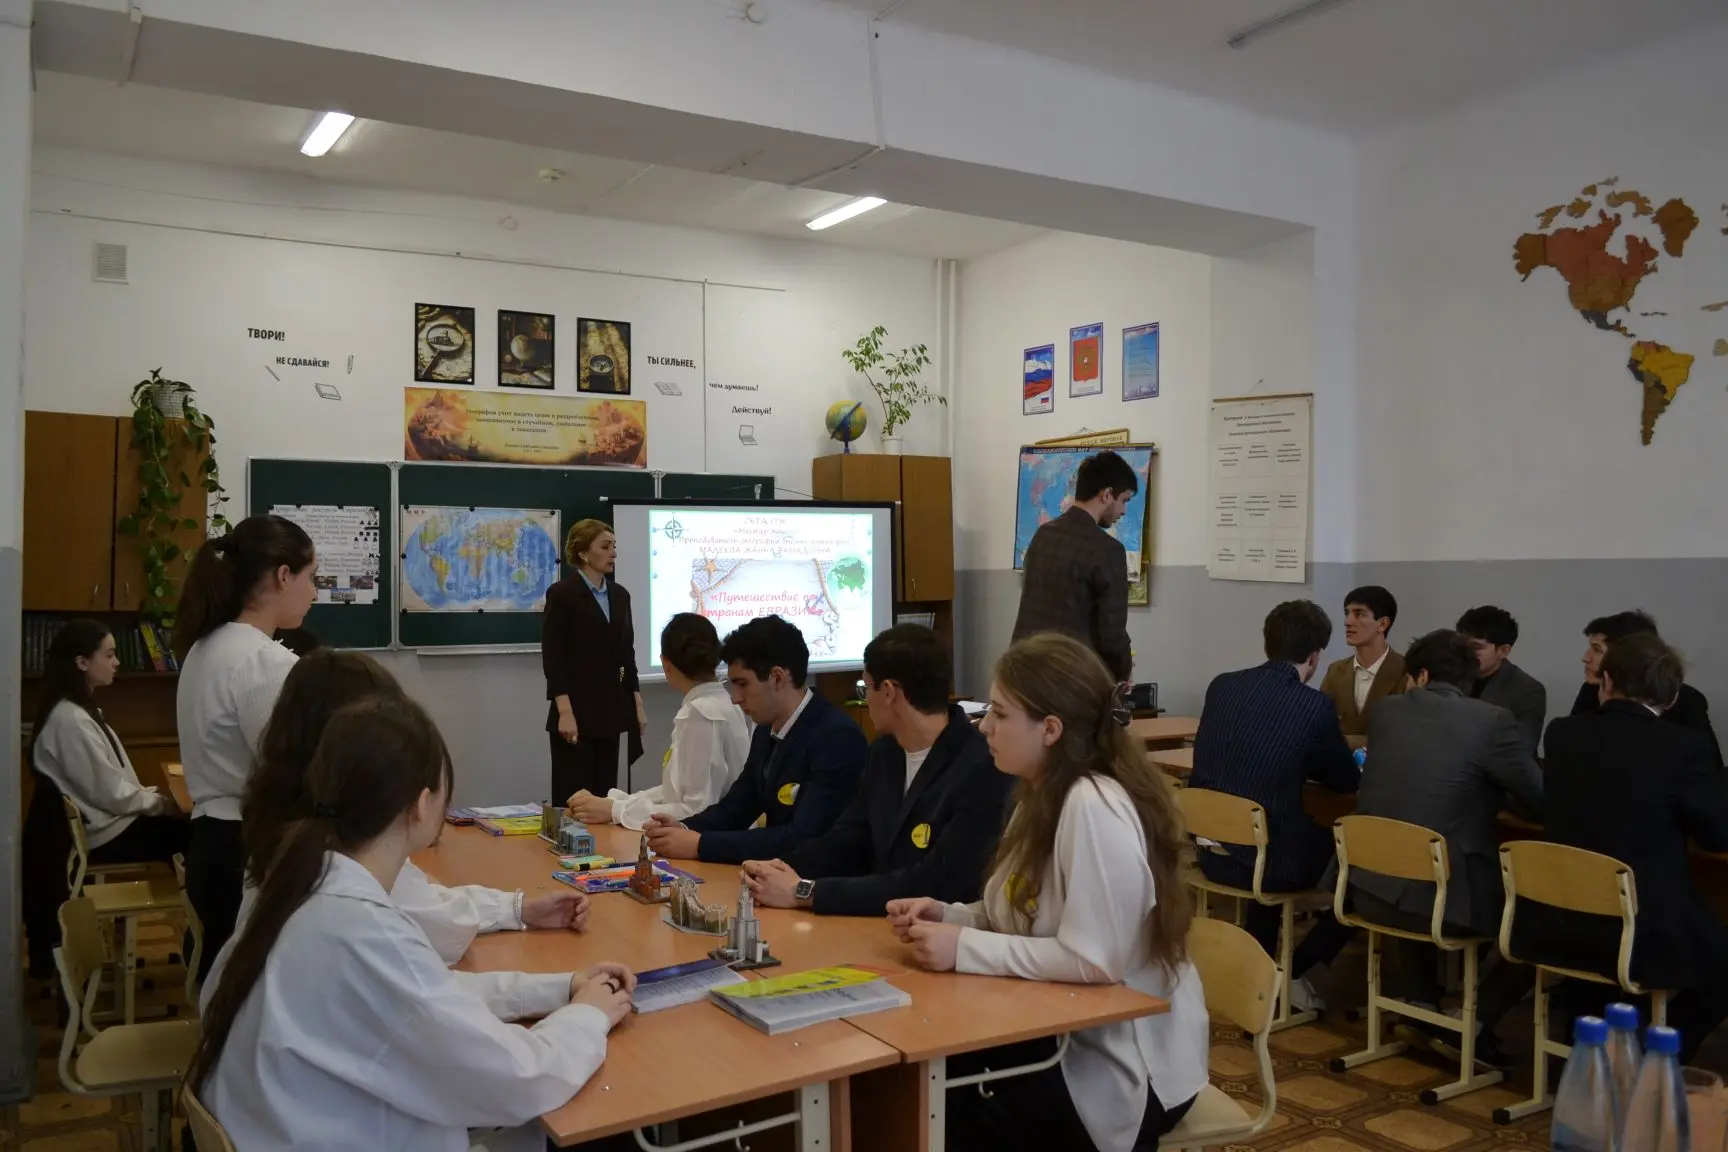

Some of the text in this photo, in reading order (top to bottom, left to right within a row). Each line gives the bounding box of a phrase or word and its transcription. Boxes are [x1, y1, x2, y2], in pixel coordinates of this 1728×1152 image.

[247, 327, 285, 341] ТВОРИ!
[276, 356, 330, 368] НЕ СДАВАЙСЯ!
[647, 355, 696, 369] ТЫ СИЛЬНЕЕ,
[724, 383, 759, 392] думаешь!
[731, 405, 772, 416] Действуй!
[709, 590, 799, 605] «Путешествие
